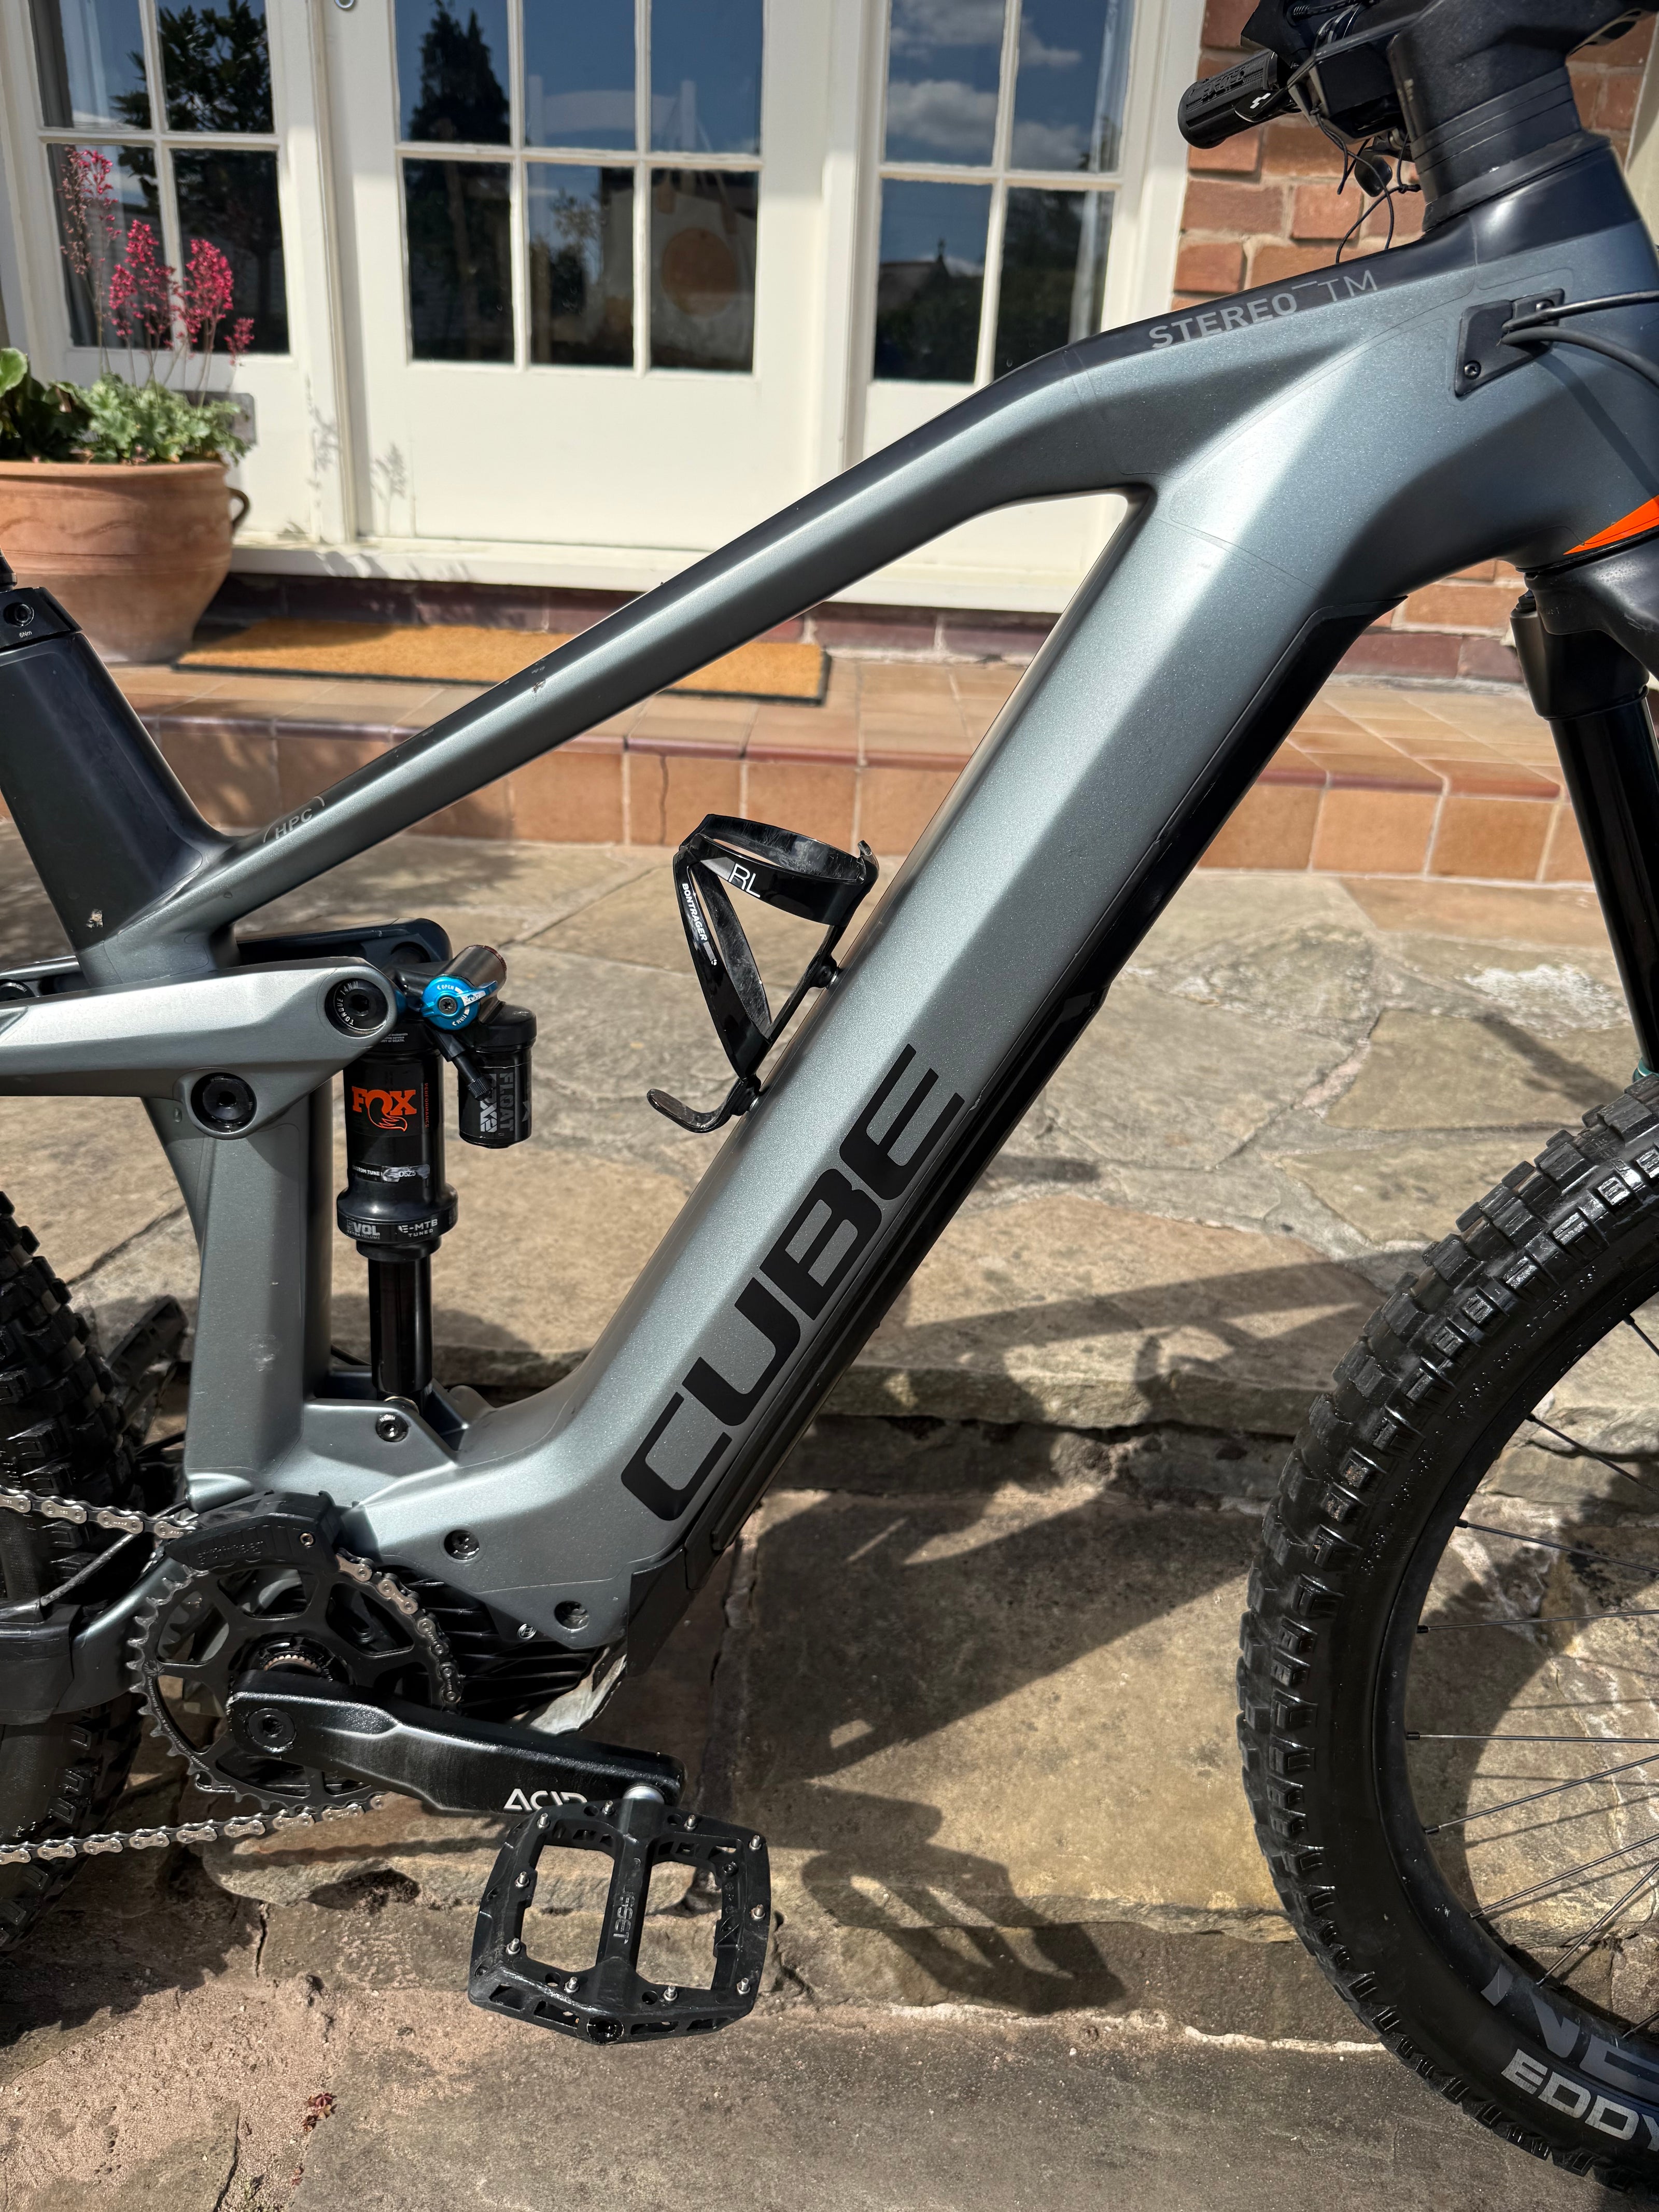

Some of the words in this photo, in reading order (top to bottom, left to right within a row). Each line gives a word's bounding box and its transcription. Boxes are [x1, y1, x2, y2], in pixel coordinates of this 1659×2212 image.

[1149, 293, 1297, 349] STEREO
[1317, 269, 1378, 302] TM
[275, 809, 312, 840] HPC
[728, 863, 761, 898] RL
[682, 883, 708, 941] BONTRAGER
[337, 997, 354, 1025] TORQUE
[456, 1014, 467, 1024] FIRM
[352, 1086, 417, 1132] FOX
[500, 1072, 514, 1132] FLOAT
[398, 1218, 438, 1233] E-MTB
[409, 1228, 433, 1237] TUNED
[621, 1042, 965, 1521] CUBE
[503, 1788, 587, 1811] ACID
